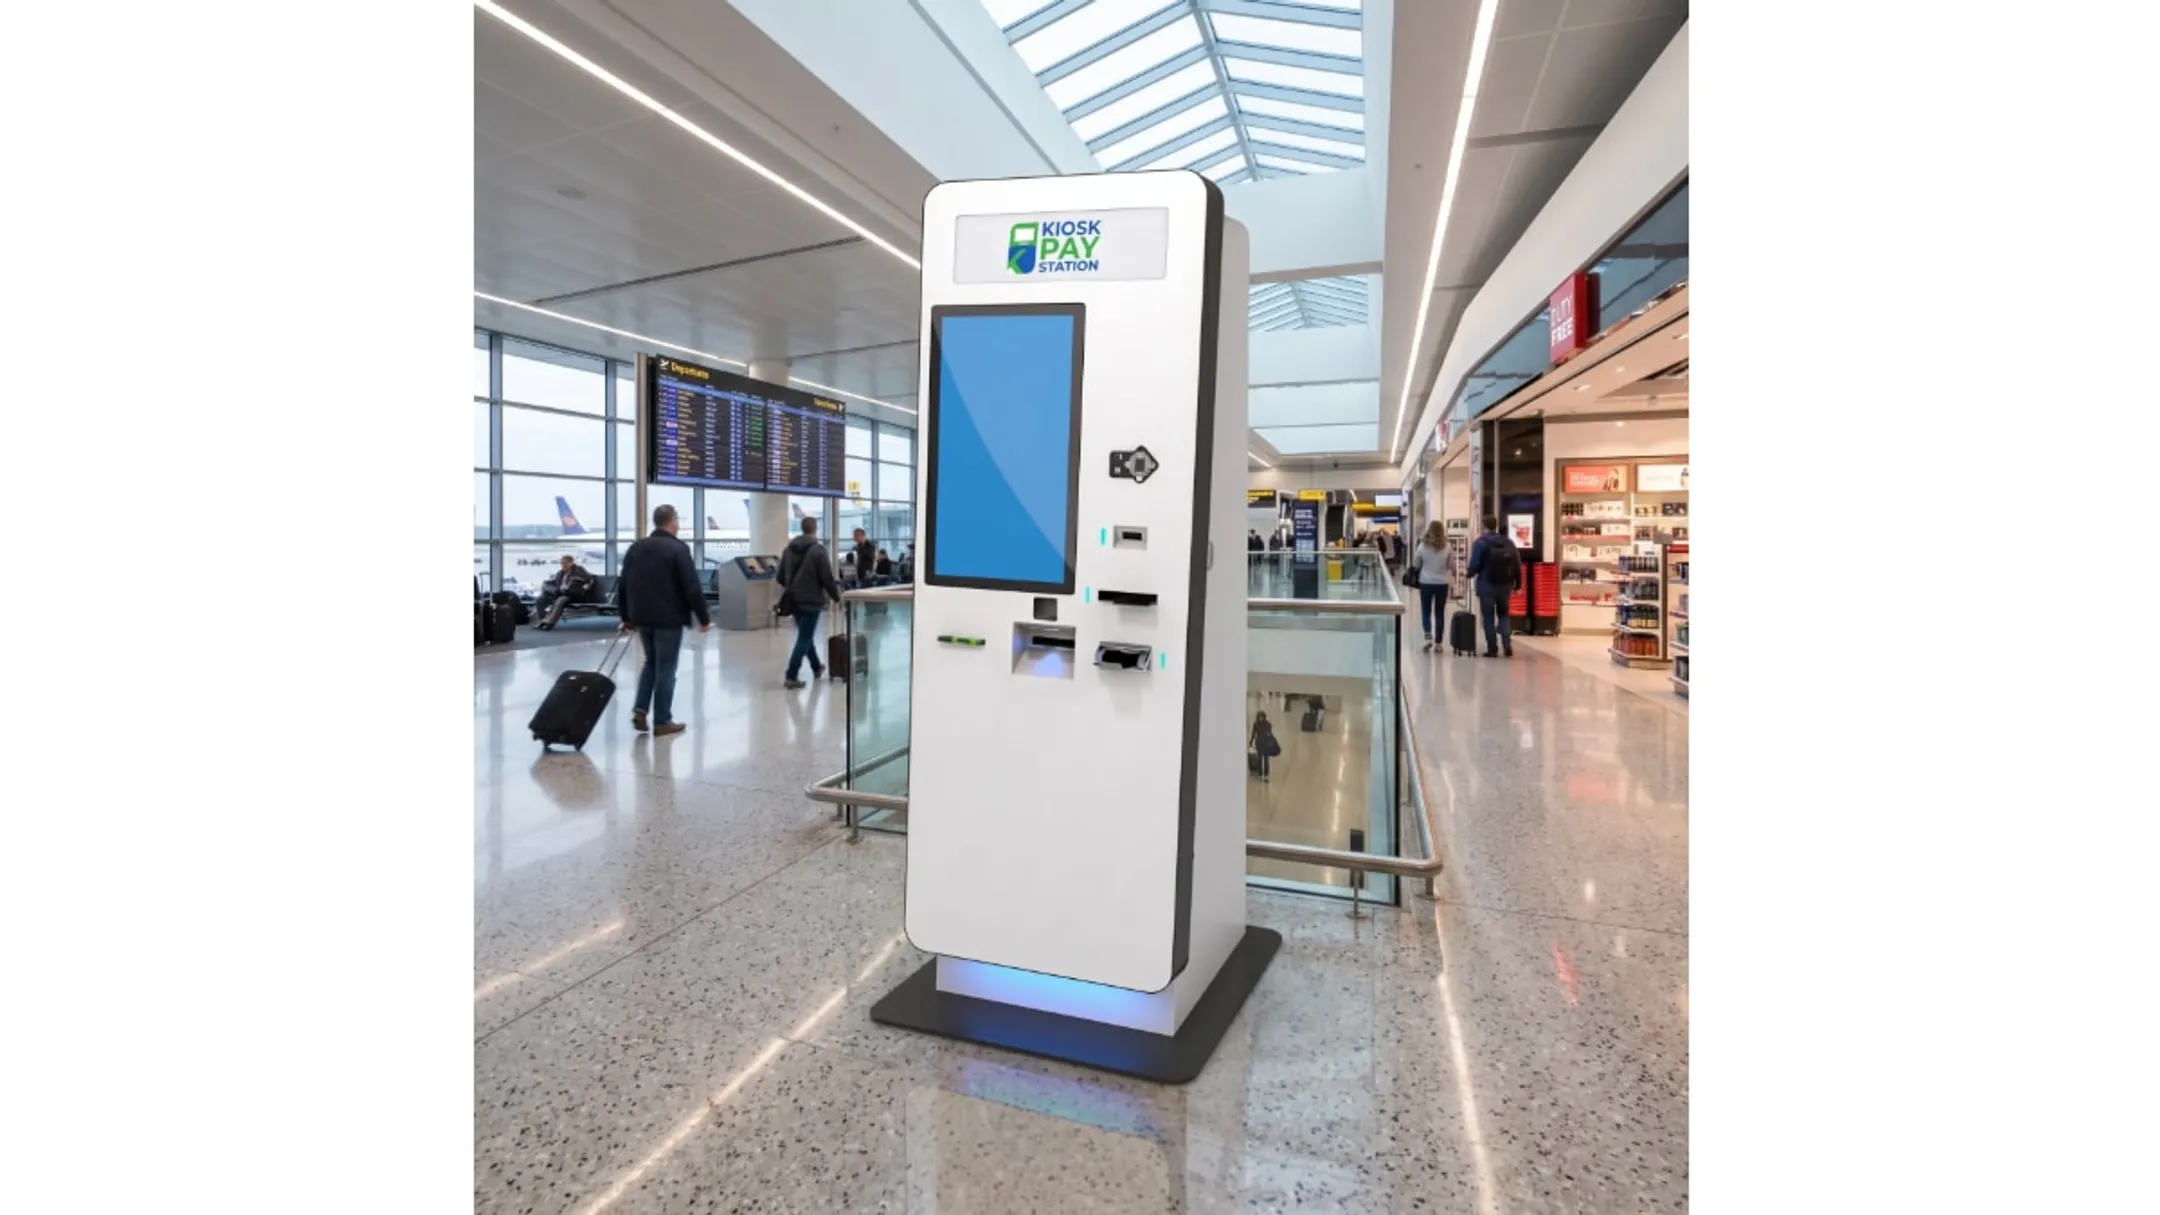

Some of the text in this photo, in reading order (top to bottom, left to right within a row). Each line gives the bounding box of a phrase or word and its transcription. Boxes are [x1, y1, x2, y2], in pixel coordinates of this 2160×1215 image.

[1042, 219, 1102, 237] KIOSK
[1040, 235, 1101, 260] PAY
[1038, 259, 1100, 273] STATION
[1551, 316, 1573, 347] FREE
